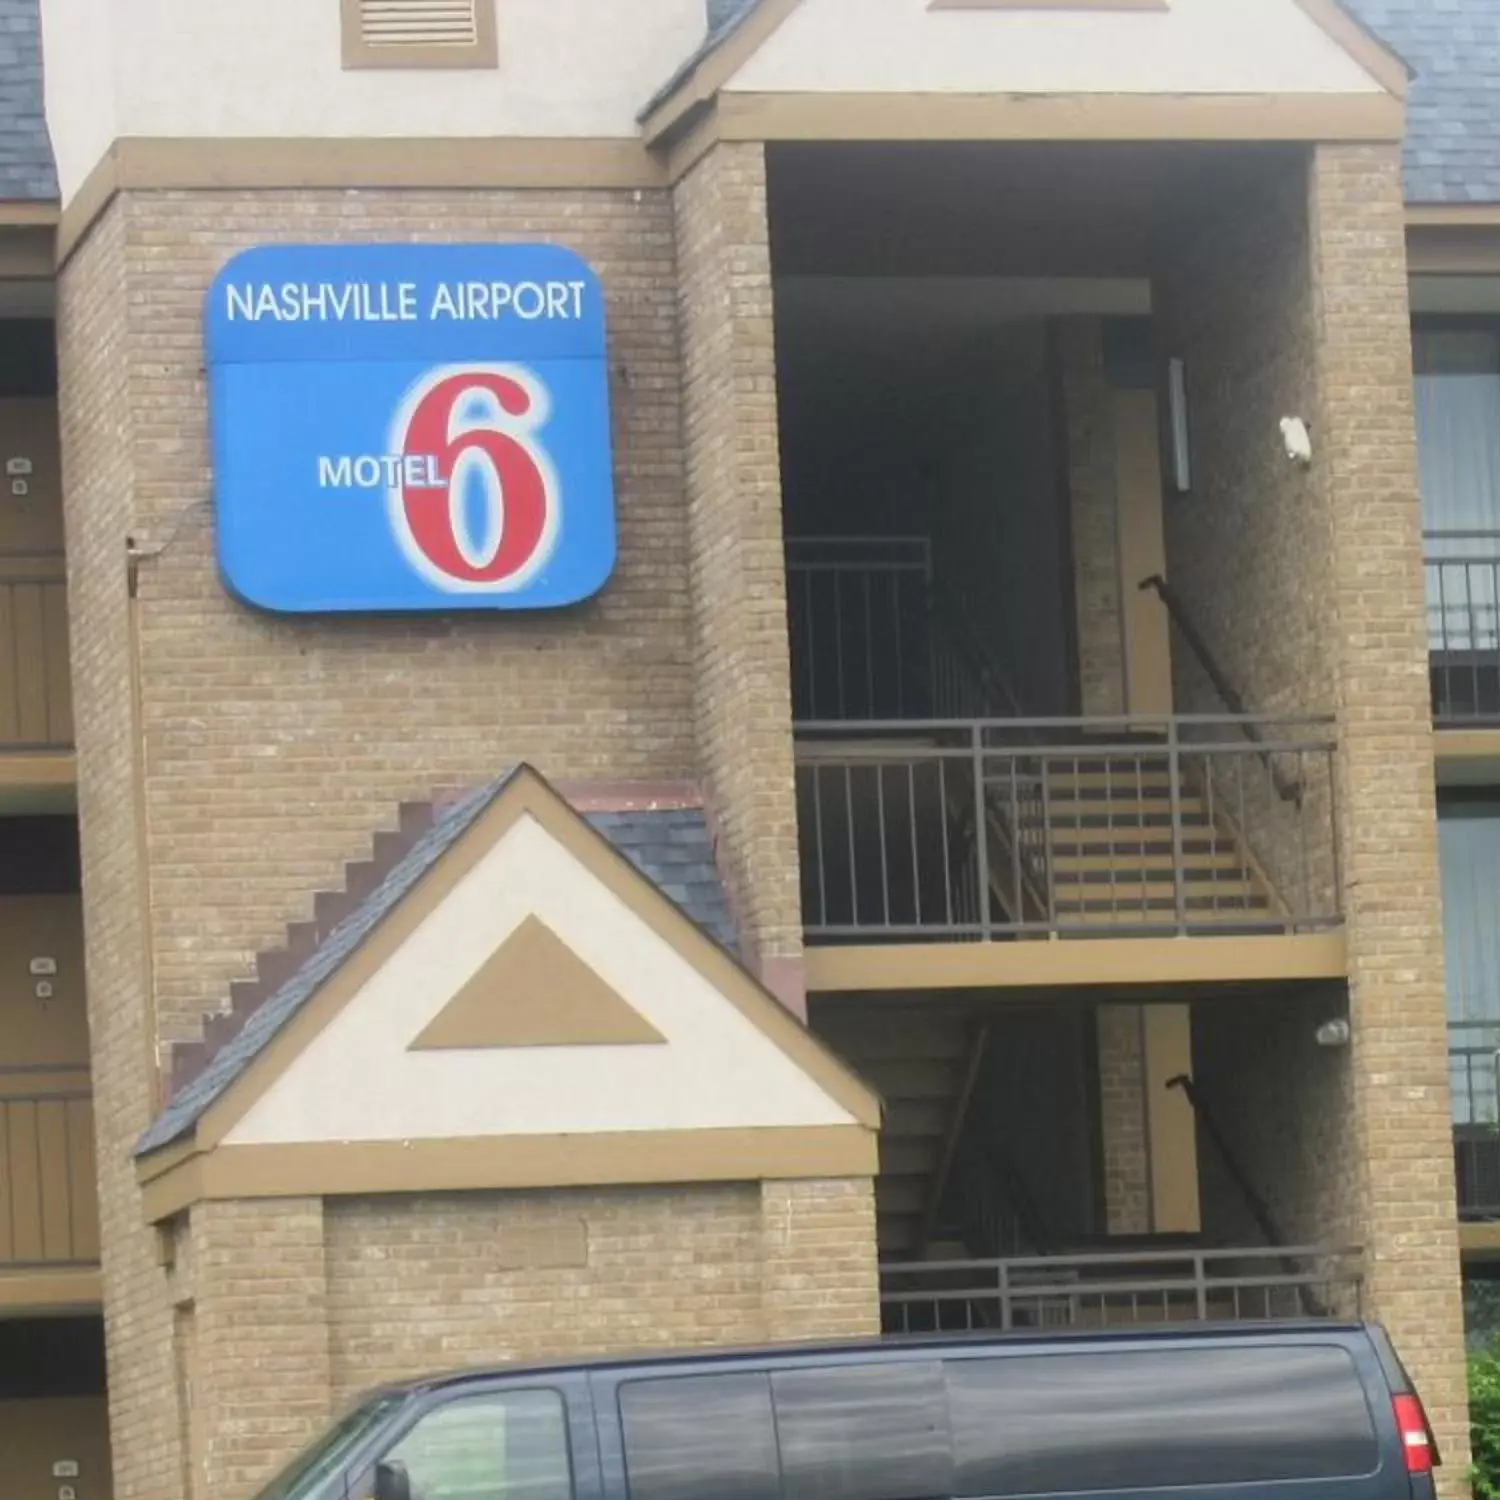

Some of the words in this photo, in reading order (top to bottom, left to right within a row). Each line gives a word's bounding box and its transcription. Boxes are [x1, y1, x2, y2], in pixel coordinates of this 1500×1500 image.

[226, 282, 418, 321] NASHVILLE
[429, 280, 586, 320] AIRPORT
[318, 455, 449, 489] MOTEL
[397, 367, 555, 588] 6
